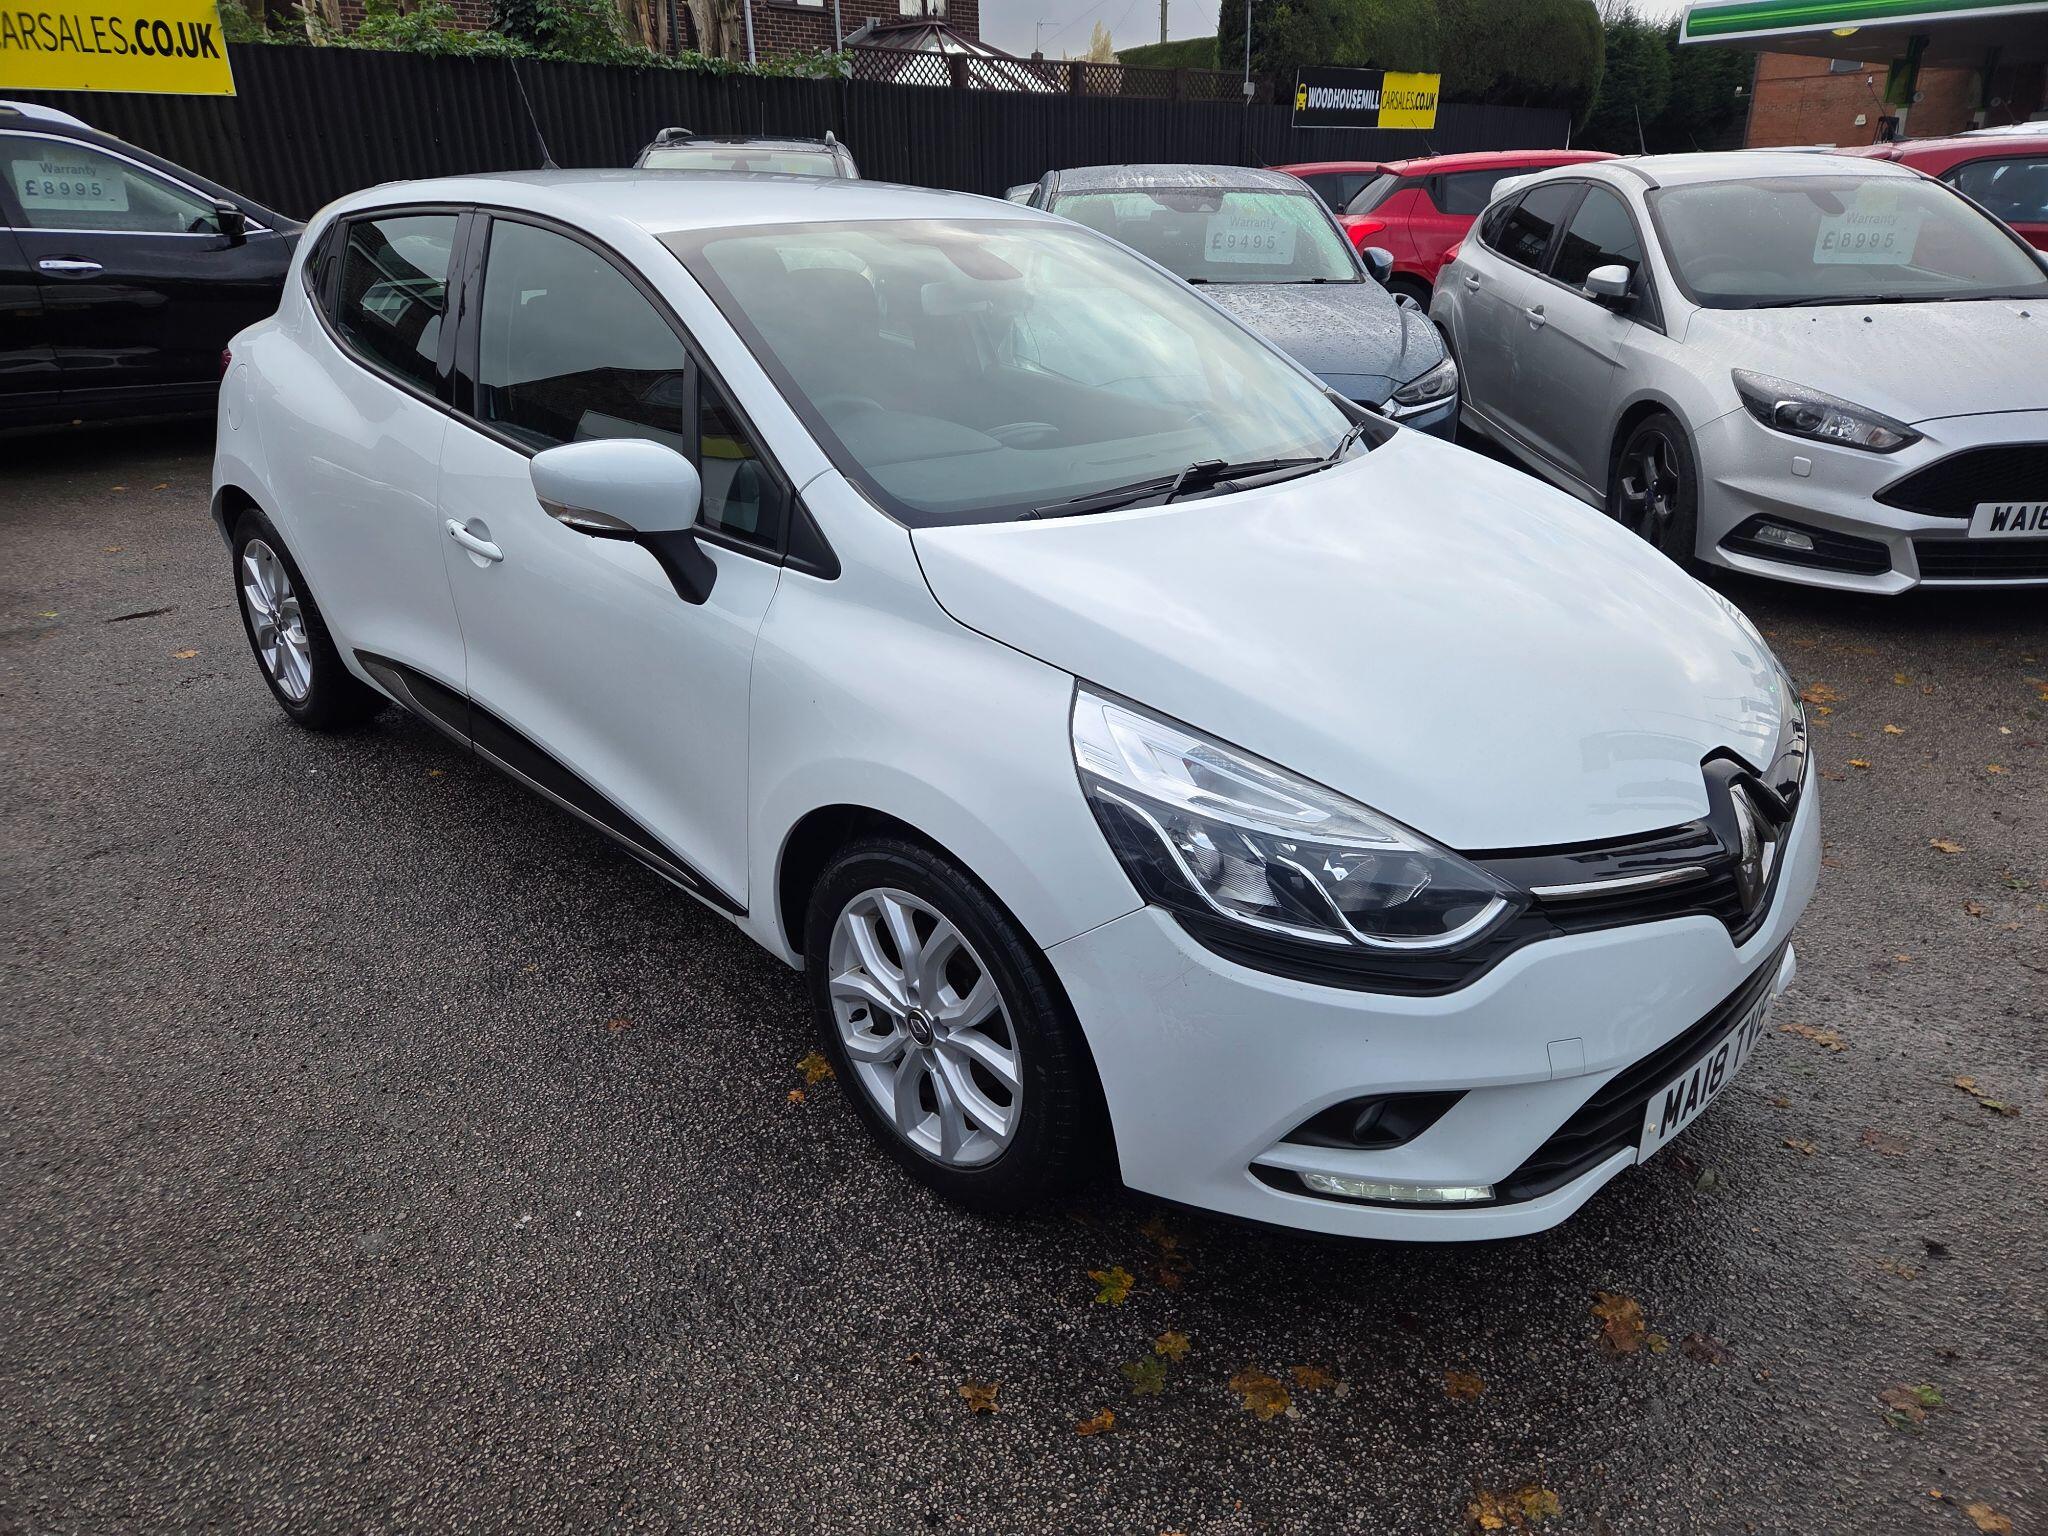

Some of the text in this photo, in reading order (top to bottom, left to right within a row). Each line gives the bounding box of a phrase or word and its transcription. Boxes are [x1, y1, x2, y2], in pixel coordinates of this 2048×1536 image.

[0, 12, 221, 59] ARSALES.CO.UK
[1308, 86, 1436, 111] WOODHOUSEMILL CARSALES.CO.UK
[40, 163, 97, 176] Warranty
[25, 180, 102, 196] £8995
[1231, 216, 1276, 230] Warranty
[1846, 212, 1897, 225] Warranty
[1212, 232, 1275, 249] £9495
[1822, 231, 1895, 250] £8995
[1659, 1043, 1729, 1139] MA18
